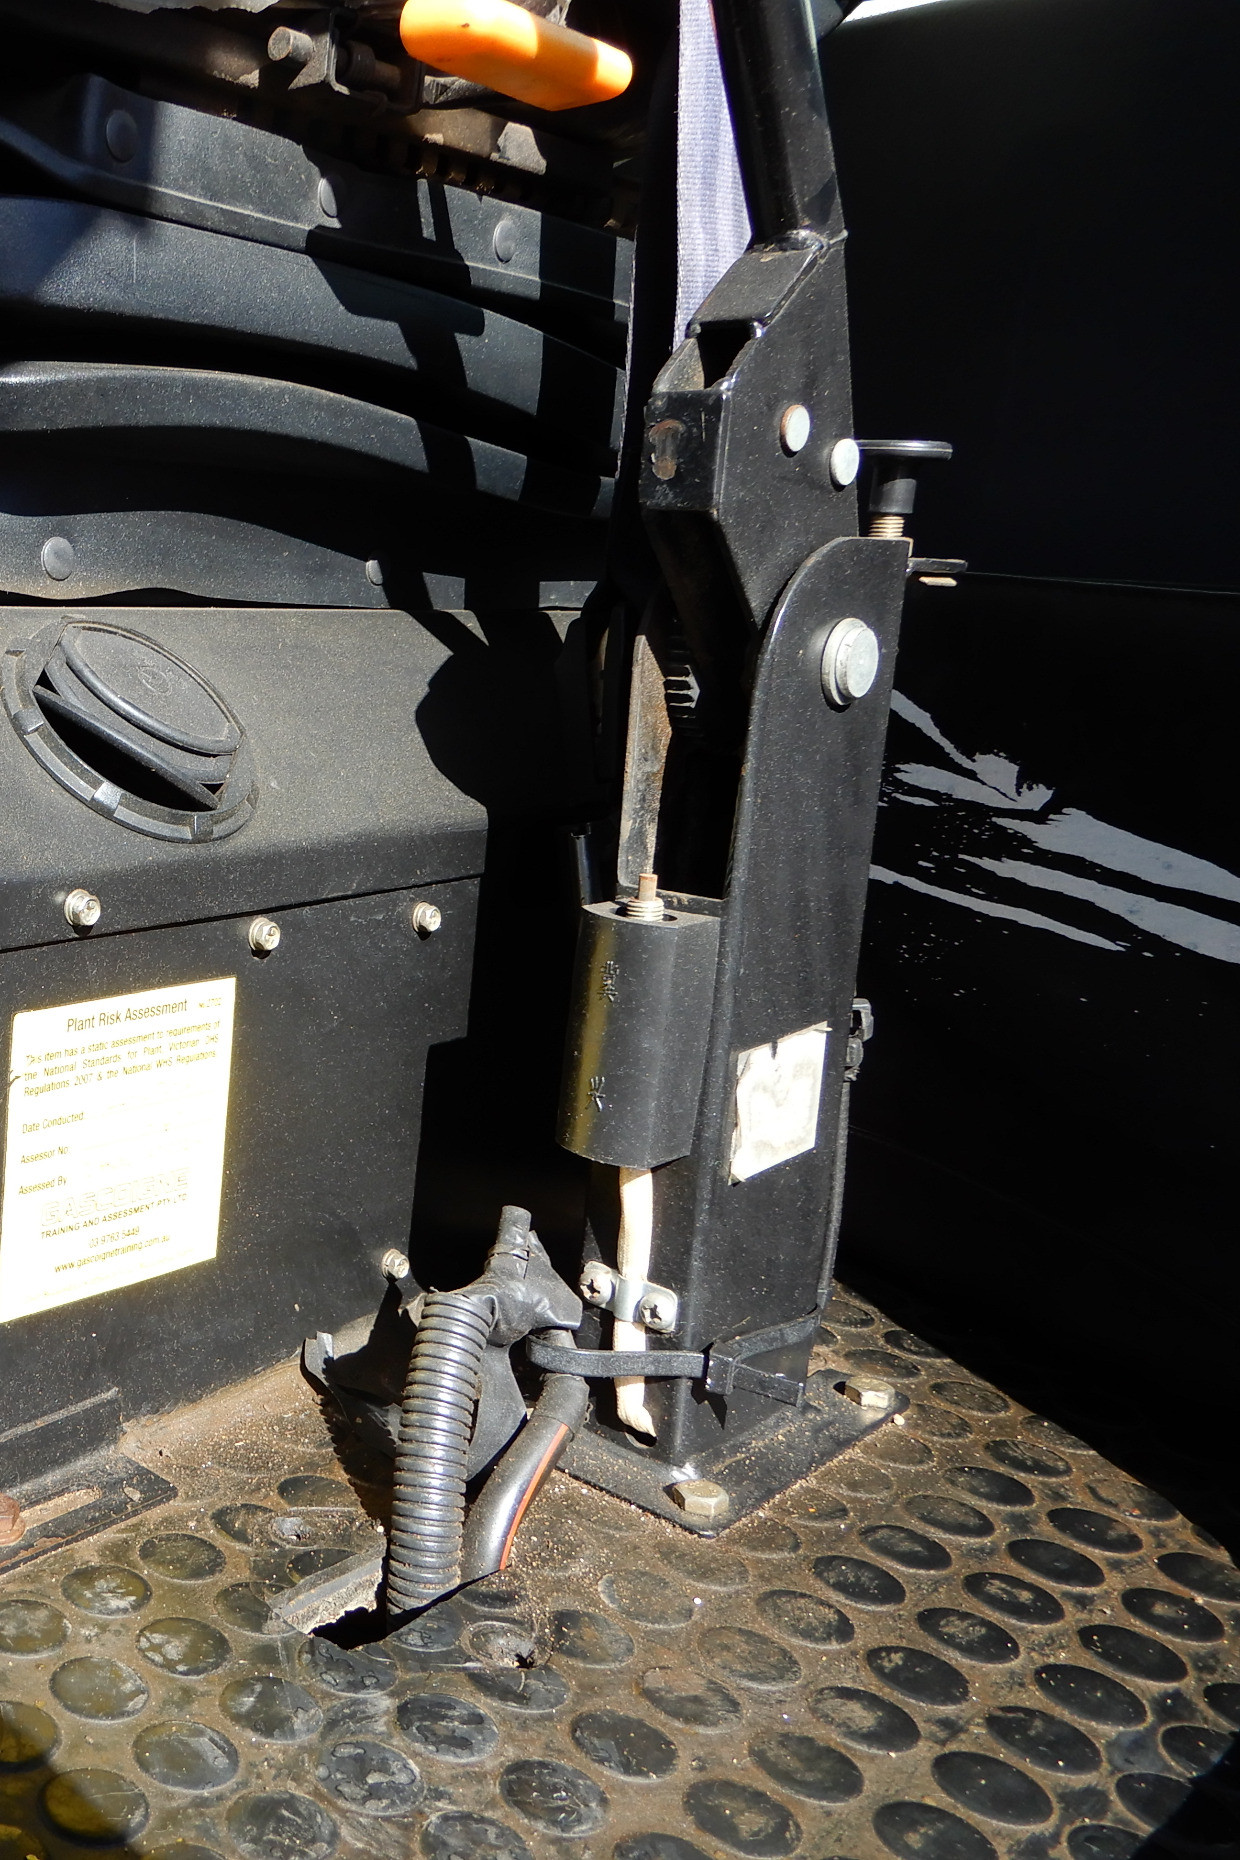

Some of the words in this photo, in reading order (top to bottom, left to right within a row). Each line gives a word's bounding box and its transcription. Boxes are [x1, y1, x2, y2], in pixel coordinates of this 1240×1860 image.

[66, 1014, 95, 1033] Plant
[98, 1010, 122, 1027] Risk
[124, 998, 188, 1022] Assessment
[44, 1049, 62, 1062] item
[64, 1044, 79, 1058] has
[80, 1046, 86, 1055] a
[87, 1040, 109, 1053] static
[110, 1031, 155, 1049] assessment
[165, 1022, 212, 1039] requirements
[24, 1070, 37, 1082] the
[43, 1061, 77, 1077] National
[82, 1053, 122, 1069] Standards
[126, 1048, 137, 1060] for
[168, 1038, 200, 1052] Victorian
[73, 1073, 93, 1087] 2007
[96, 1071, 103, 1082] &
[106, 1069, 119, 1080] the
[122, 1062, 153, 1077] National
[21, 1122, 41, 1134] Date
[20, 1149, 55, 1165] Assessor
[18, 1178, 55, 1196] Assessed
[40, 1222, 80, 1240] TRAINING
[82, 1218, 100, 1229] AND
[101, 1202, 155, 1223] ASSESSMENT
[156, 1197, 172, 1209] PTY
